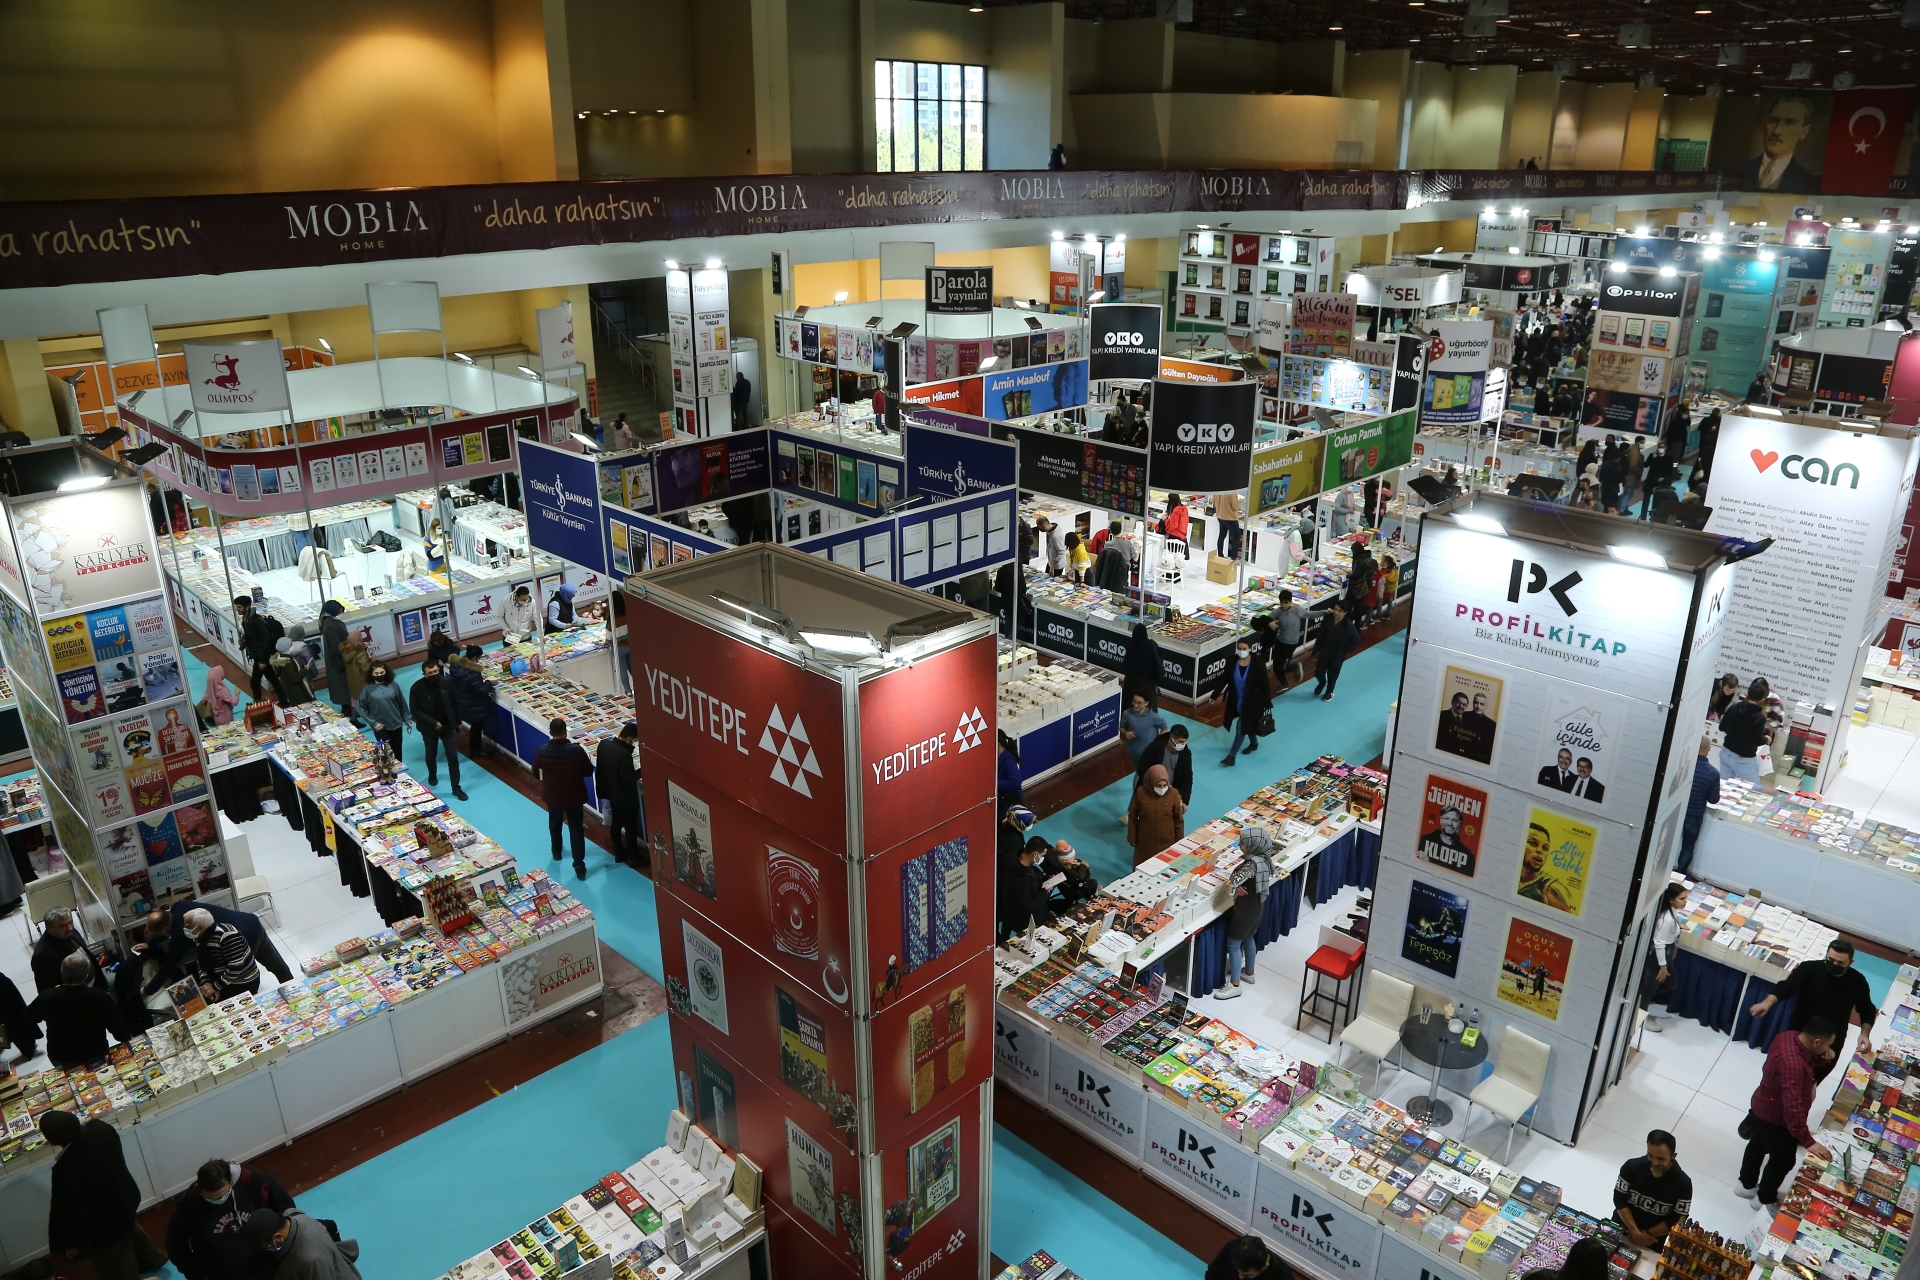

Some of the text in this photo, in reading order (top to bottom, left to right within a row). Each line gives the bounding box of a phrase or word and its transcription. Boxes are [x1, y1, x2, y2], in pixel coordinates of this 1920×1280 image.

[474, 195, 661, 228] "daha rahatsın"
[748, 215, 779, 224] HOME
[340, 240, 386, 252] HOME
[1630, 250, 1655, 260] Kronik
[694, 282, 727, 294] hayykitap
[932, 270, 988, 303] Parola
[948, 290, 988, 303] yayınları
[1104, 332, 1144, 345] YKY
[1449, 339, 1489, 349] uğurböceği
[1105, 346, 1124, 354] KREDİ
[1125, 347, 1158, 355] YAYINLARI
[1448, 350, 1480, 359] yayınları
[116, 374, 155, 389] CEZVE
[992, 370, 1050, 391] Amin Maalouf
[1162, 367, 1186, 380] Gülten
[1396, 370, 1411, 378] YAPI
[207, 393, 254, 404] OLİMPOS
[932, 390, 960, 401] Hikmet
[1177, 423, 1235, 443] YKY
[1333, 423, 1384, 448] Orhan Pamuk
[1154, 441, 1250, 455] YAPI KREDİ YAYINLARI
[729, 454, 751, 463] ATATÜRK
[1040, 455, 1076, 468] Ahmet Ümit
[1253, 450, 1303, 475] Sabahattin Ali
[918, 466, 1004, 491] TÜRKİYE BANKA
[1780, 454, 1861, 490] can
[530, 479, 593, 508] TÜRKİYE BANKASI
[1721, 496, 1741, 504] Salman
[1743, 499, 1765, 509] Rushdie
[1800, 510, 1818, 519] Abidin
[542, 508, 586, 533] Kültür Yayınları
[1718, 505, 1736, 513] Ahmet
[1800, 519, 1814, 528] Altay
[1818, 521, 1837, 531] Öktem
[1737, 518, 1752, 526] Ayfer
[1821, 534, 1841, 542] Munro
[1779, 545, 1814, 557] Anton Çehov
[77, 556, 149, 576] YAYINCILIK
[1807, 560, 1840, 571] Aydın Büke
[1752, 577, 1793, 590] Berna Durmaz
[1810, 570, 1855, 584] Adnan Binyazar
[1817, 581, 1853, 593] Behçet Çelik
[1743, 603, 1768, 613] Charlotte
[1798, 596, 1812, 604] Onur
[1802, 606, 1846, 621] Petros Markaris
[1047, 622, 1074, 639] YKY
[1455, 603, 1627, 656] PROFİLKİTAP
[1735, 629, 1754, 638] Joseph
[1765, 617, 1842, 639] Nejat Dino
[1099, 639, 1127, 657] YKY
[1474, 627, 1600, 669] Biz Kitaba İnanıyoruz
[1824, 640, 1840, 648] Erdal
[143, 657, 175, 669] Yönetimi
[148, 652, 167, 662] Proje
[643, 663, 749, 756] YEDİTEPE
[1565, 721, 1594, 737] aile
[1556, 730, 1602, 752] içinde
[872, 732, 947, 785] YEDİTEPE
[672, 795, 708, 824] KORSANLAR
[1427, 785, 1483, 818] JÜRGEN
[1572, 827, 1592, 837] MARCUS
[1424, 839, 1468, 869] KLOPP
[1516, 937, 1560, 960] KAĞAN
[1523, 931, 1556, 949] OĞUZ
[1408, 936, 1452, 963] Tepegöz
[541, 966, 595, 995] YAYINCILIK
[1054, 1084, 1135, 1138] PROFİLKİTAP
[791, 1129, 832, 1173] HUNLAR
[1151, 1140, 1242, 1201] PROFİLKİTAP
[1162, 1157, 1173, 1168] Biz
[1174, 1161, 1196, 1180] Kitaba
[1260, 1206, 1361, 1271] PROFİLKİTAP
[1272, 1223, 1284, 1235] Biz
[1284, 1229, 1308, 1249] Kitaba
